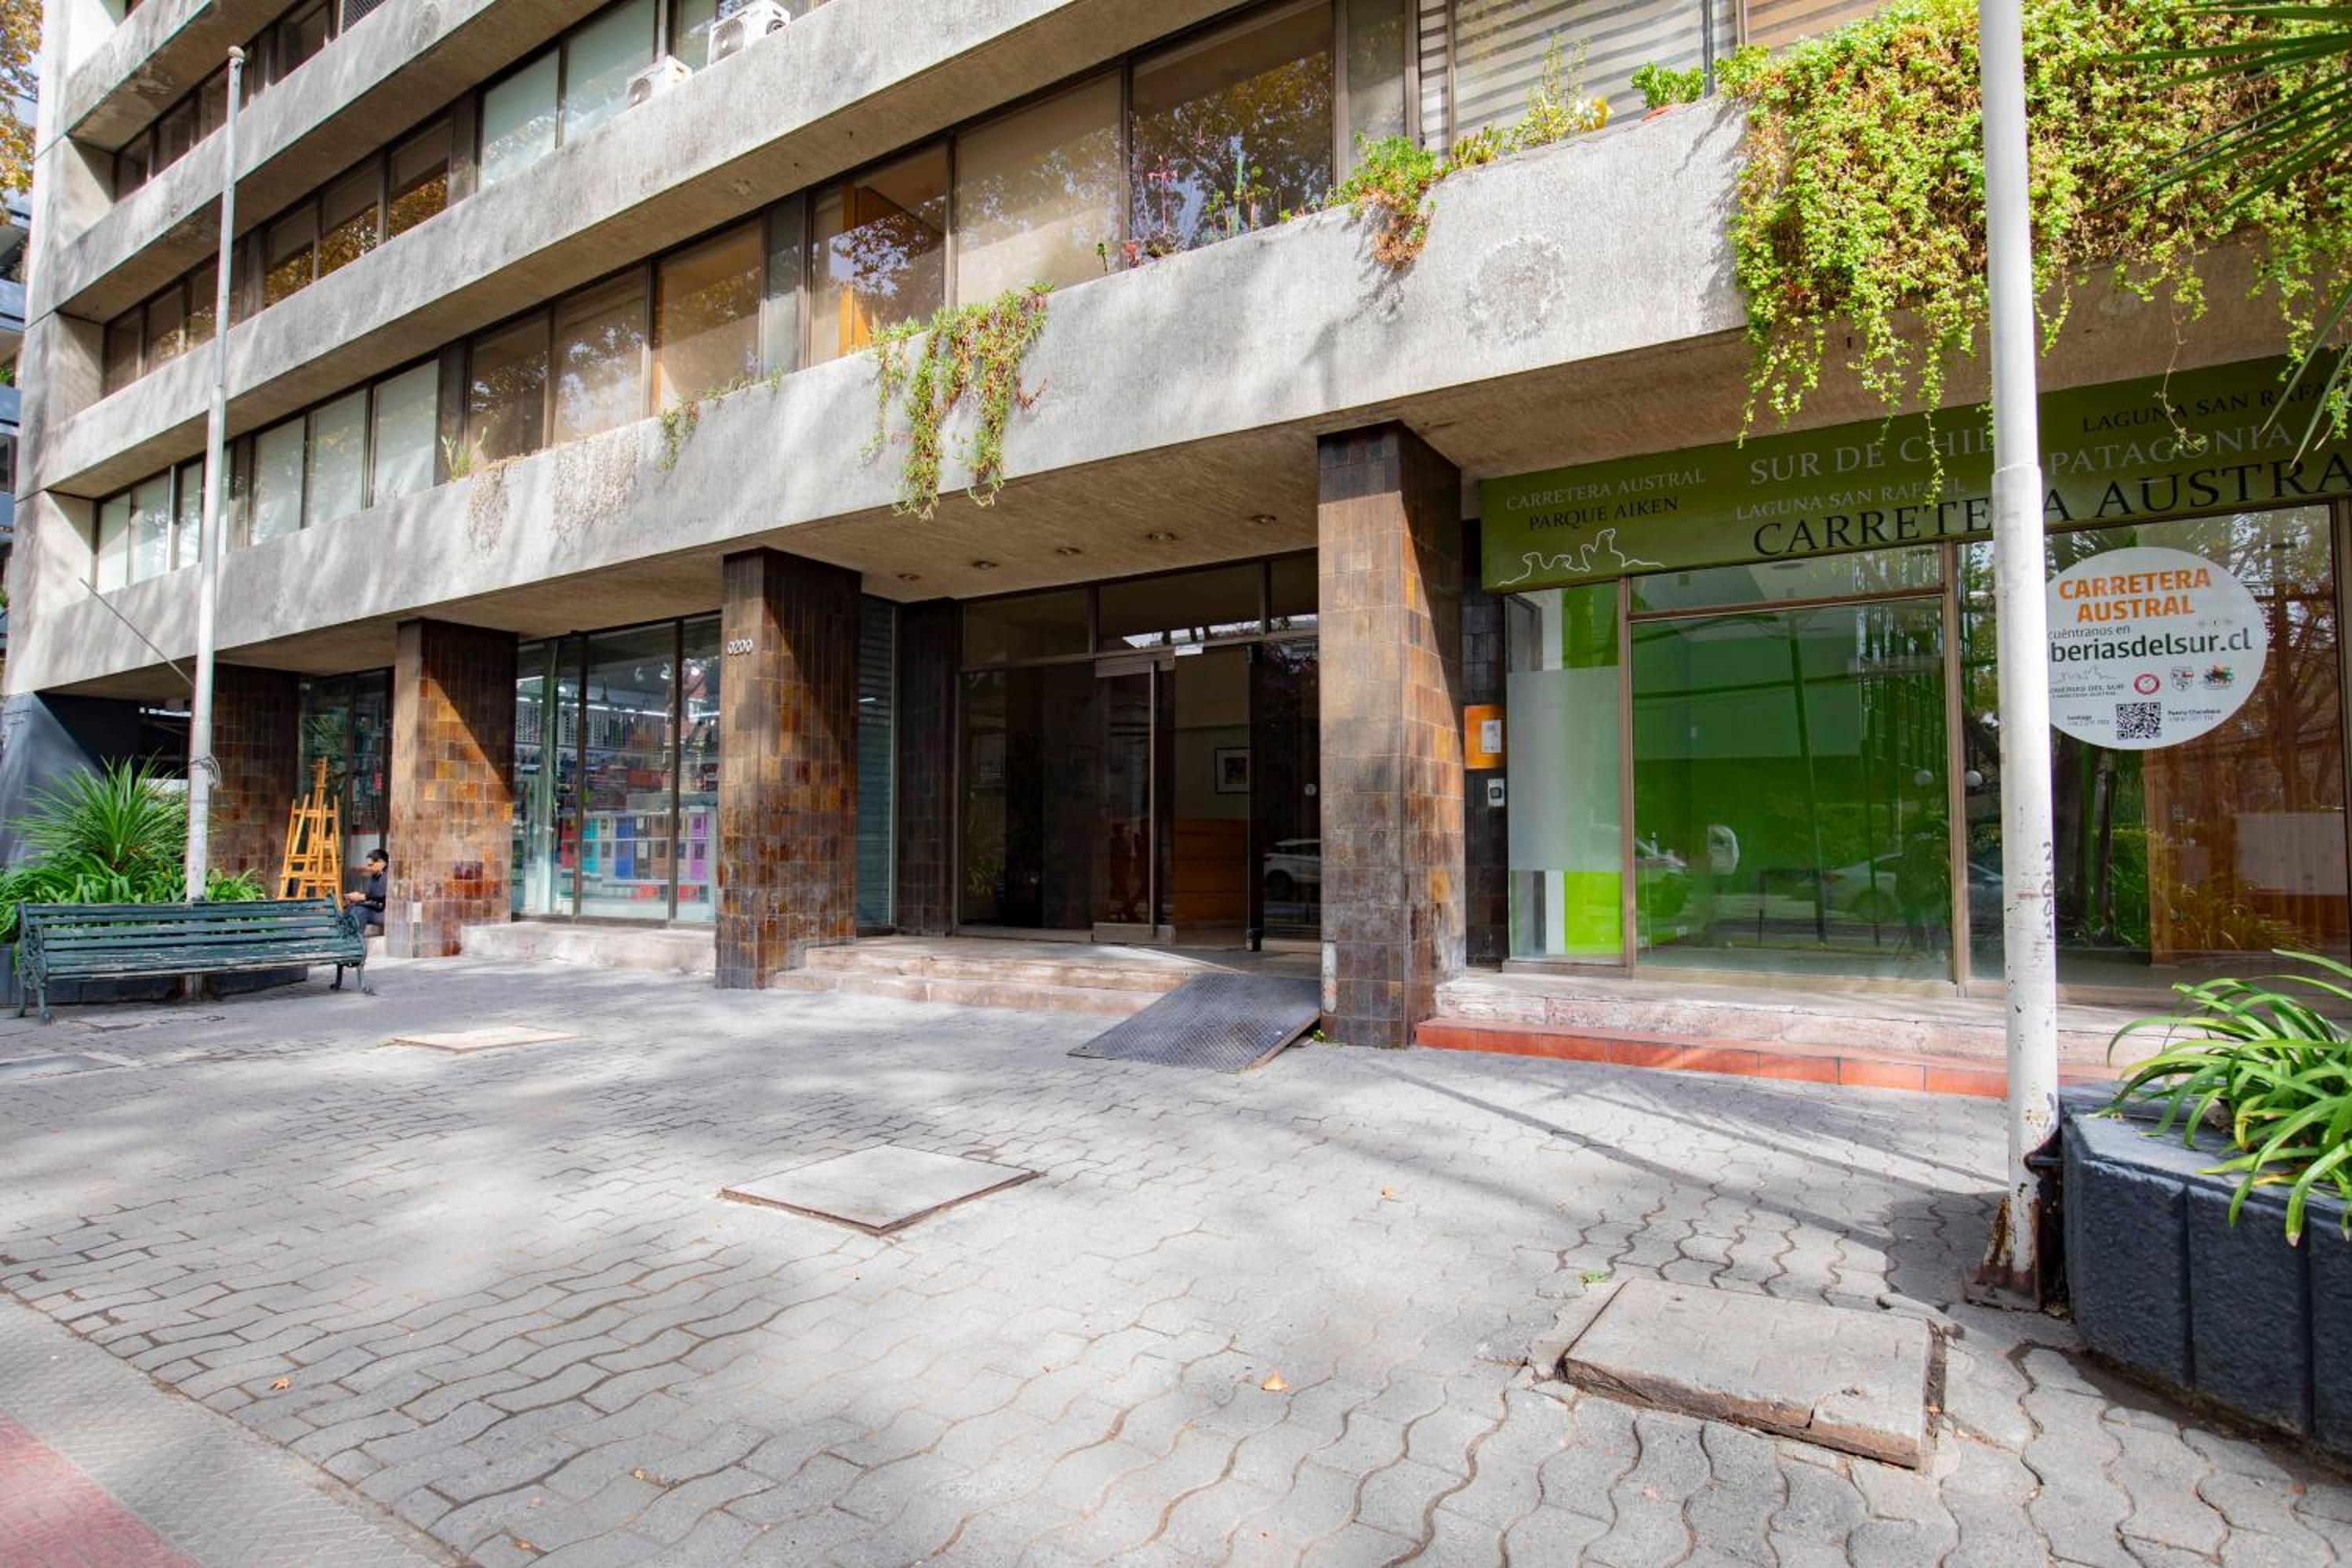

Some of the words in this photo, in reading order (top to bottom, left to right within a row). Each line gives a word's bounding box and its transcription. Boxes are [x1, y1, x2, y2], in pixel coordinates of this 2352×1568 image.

[2083, 403, 2188, 432] LAGUNA
[2197, 393, 2249, 416] SAN
[1750, 452, 1822, 486] SUR
[1835, 442, 1886, 473] DE
[1900, 427, 1993, 463] CHIL
[2049, 423, 2293, 477] PATAGONIA
[1505, 483, 1611, 510] CARRETERA
[1617, 468, 1707, 495] AUSTRAL
[1735, 495, 1822, 521] LAGUNA
[1828, 488, 1872, 508] SAN
[1753, 488, 2075, 557] CARRETEA
[2094, 452, 2352, 518] AUSTRA
[1530, 506, 1608, 531] PARQUE
[1613, 496, 1679, 520] AIKEN
[2059, 567, 2212, 600] CARRETERA
[2077, 594, 2196, 622] AUSTRAL
[2050, 627, 2252, 663] beriasdelsur.cl
[2116, 625, 2131, 635] en
